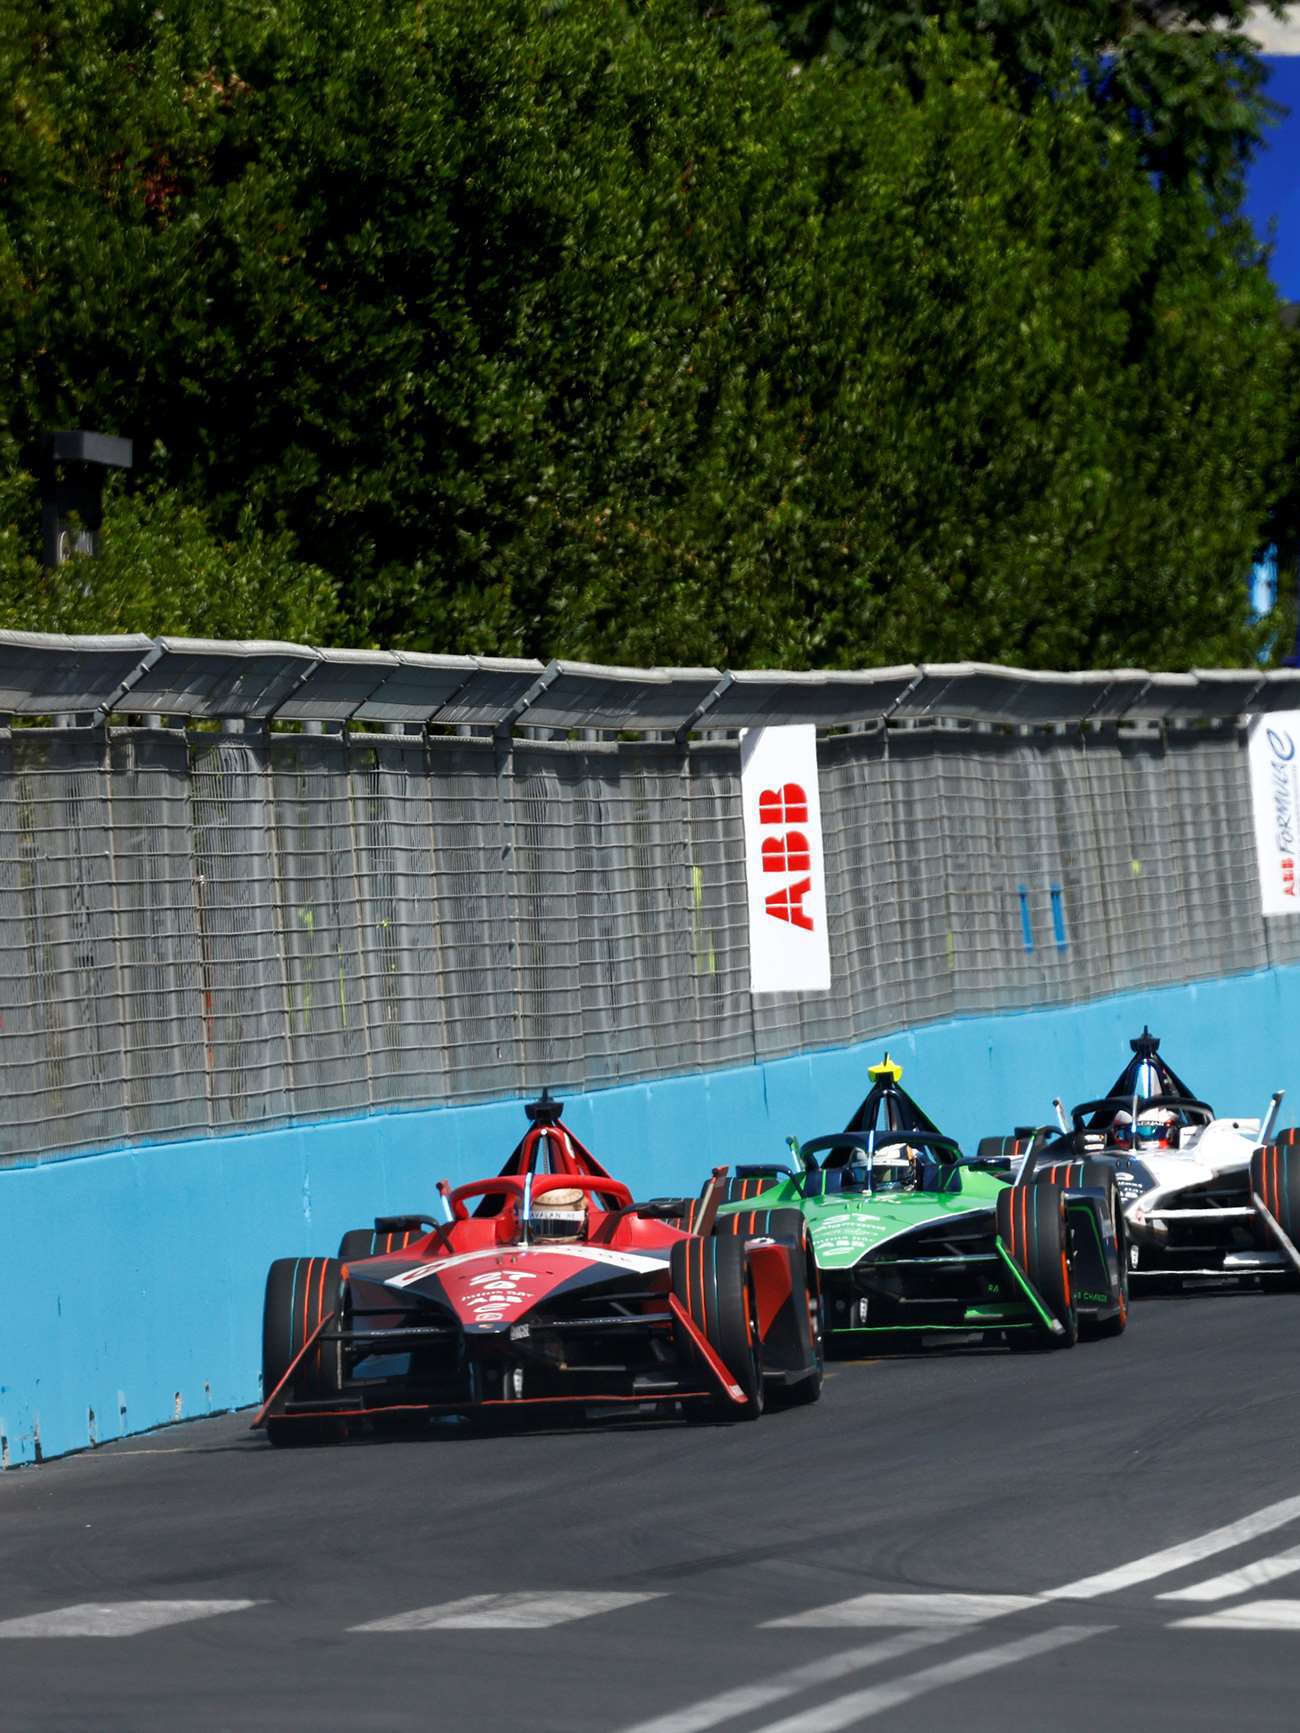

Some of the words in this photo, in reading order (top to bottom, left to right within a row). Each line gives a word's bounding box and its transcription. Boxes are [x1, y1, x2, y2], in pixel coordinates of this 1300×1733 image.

[1271, 761, 1296, 854] FORMULA
[758, 782, 815, 932] ABB
[1281, 857, 1296, 897] ABB
